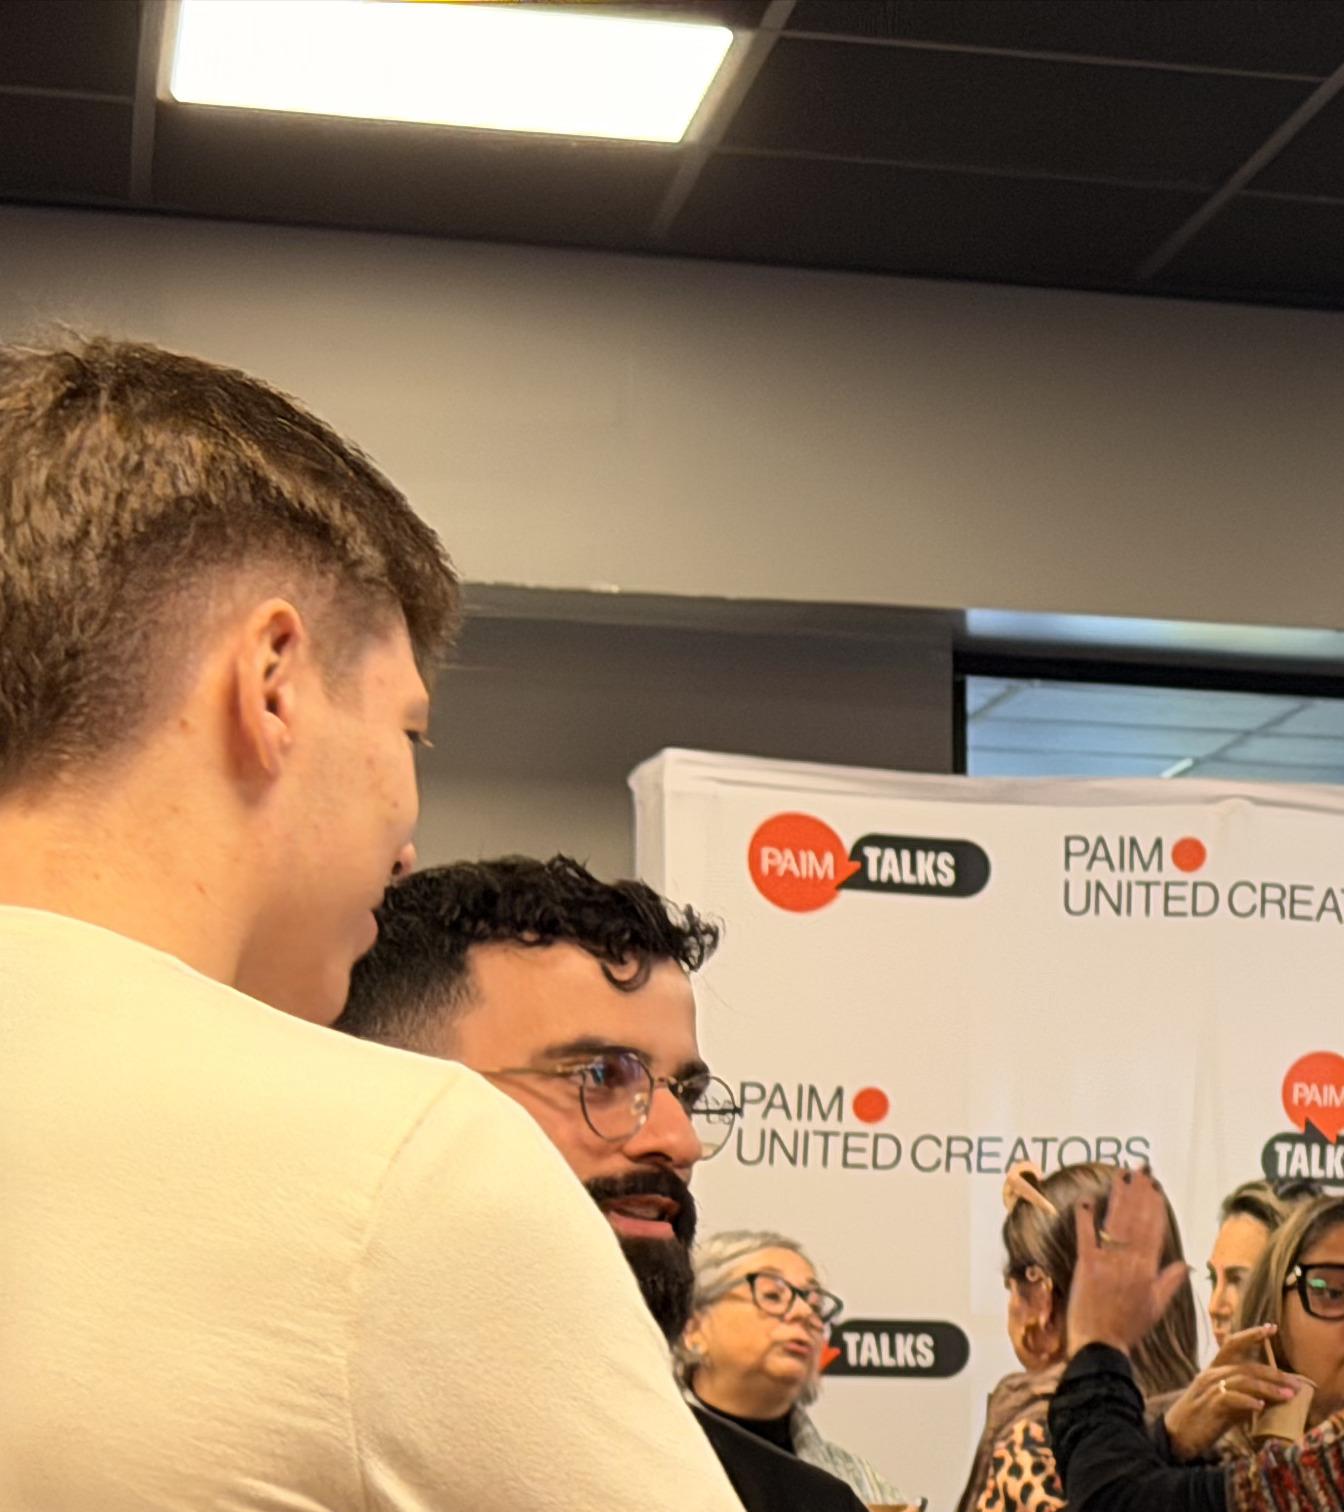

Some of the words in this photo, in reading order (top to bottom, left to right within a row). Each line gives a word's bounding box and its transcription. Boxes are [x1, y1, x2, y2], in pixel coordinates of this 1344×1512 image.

[761, 846, 835, 880] PAIM
[863, 846, 956, 887] TALKS
[1063, 834, 1164, 873] PAIM
[1063, 878, 1220, 918] UNITED
[738, 1081, 845, 1123] PAIM
[736, 1127, 902, 1170] UNITED
[842, 1331, 935, 1368] TALKS
